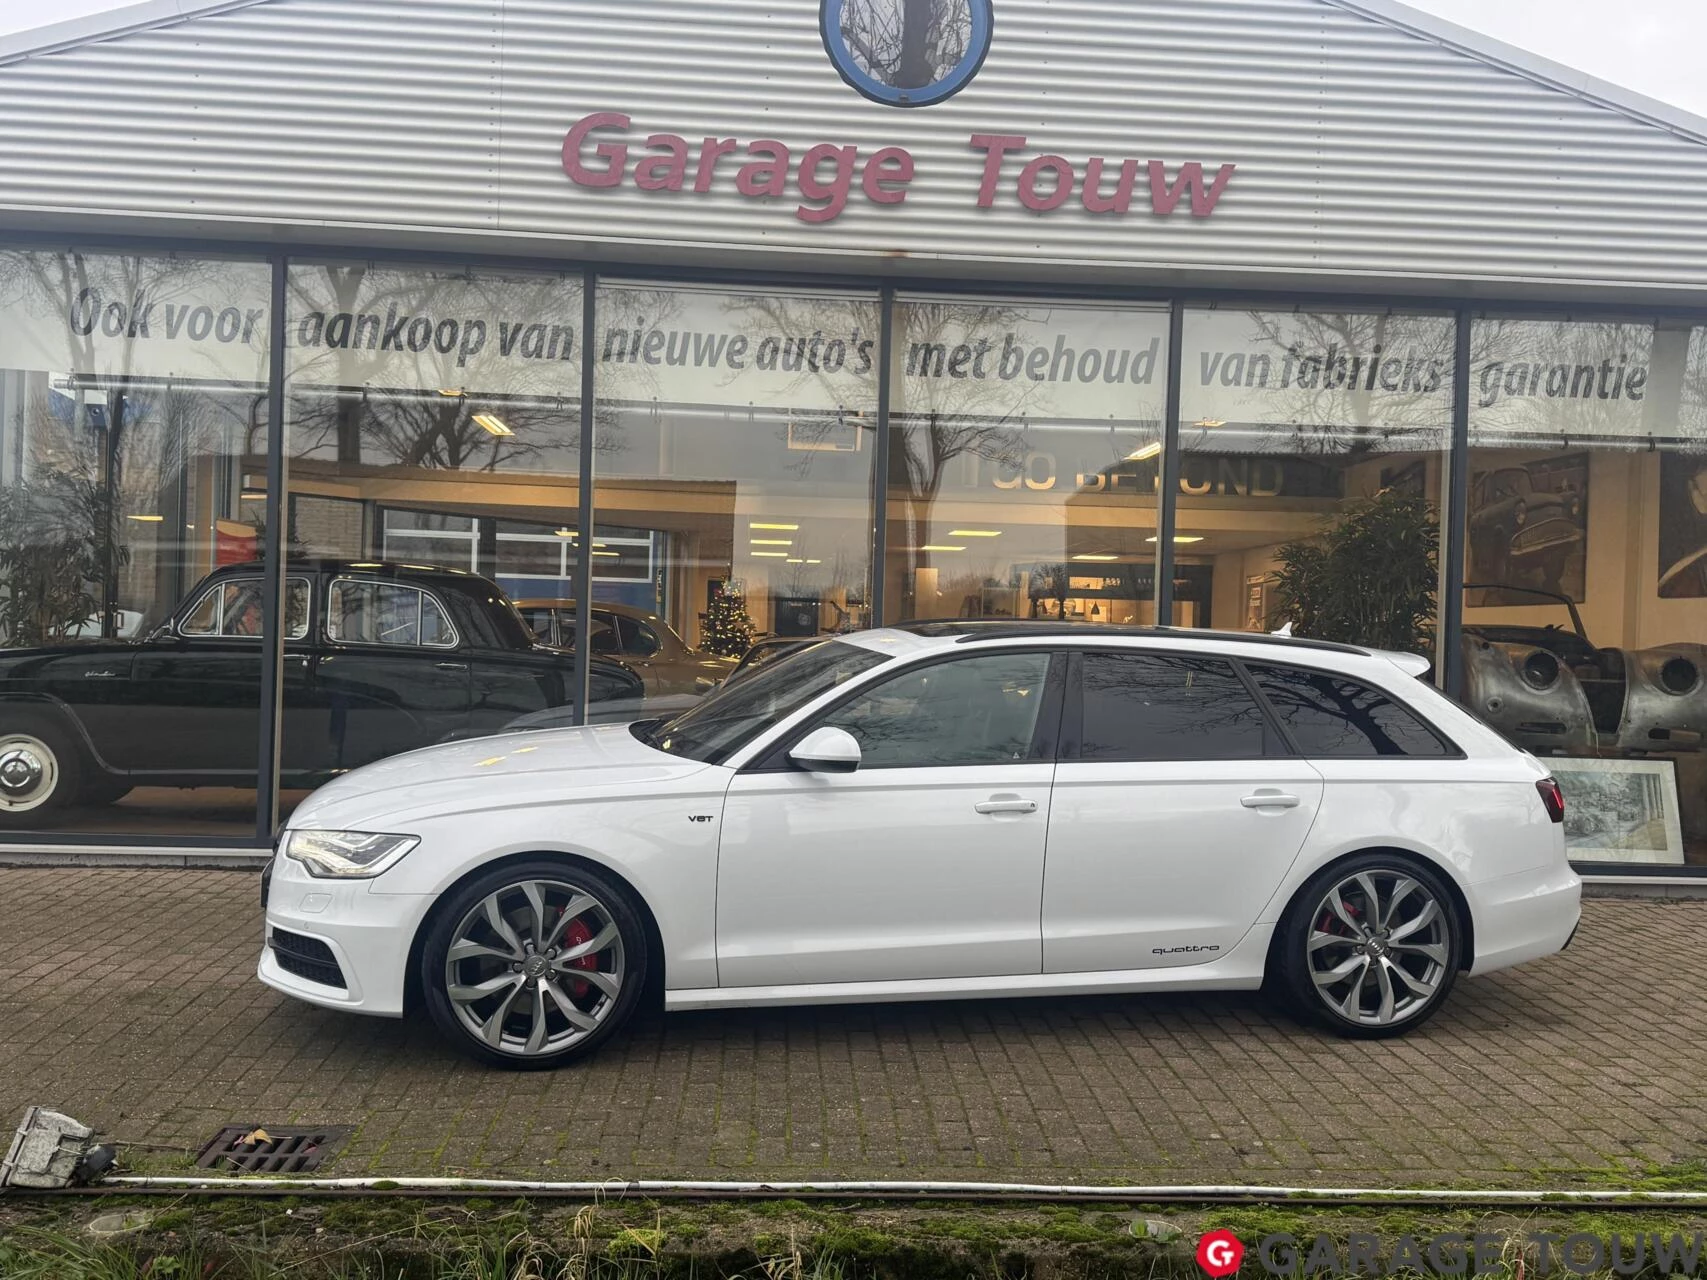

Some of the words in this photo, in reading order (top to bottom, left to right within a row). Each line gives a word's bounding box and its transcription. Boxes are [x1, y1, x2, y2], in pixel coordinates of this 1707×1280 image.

[561, 112, 914, 222] Garage
[969, 134, 1236, 216] Touw
[70, 287, 151, 338] Ook
[165, 303, 263, 344] voor
[300, 301, 486, 367] aankoop
[500, 320, 574, 361] van
[602, 315, 747, 369] nieuwe
[756, 326, 875, 374] auto's
[906, 334, 991, 380] met
[1000, 332, 1160, 385] behoud
[1201, 350, 1268, 389] van
[1279, 343, 1443, 394] fabrieks
[1478, 352, 1648, 407] garantie
[1076, 456, 1284, 497] BEOND
[1152, 945, 1220, 955] quattro
